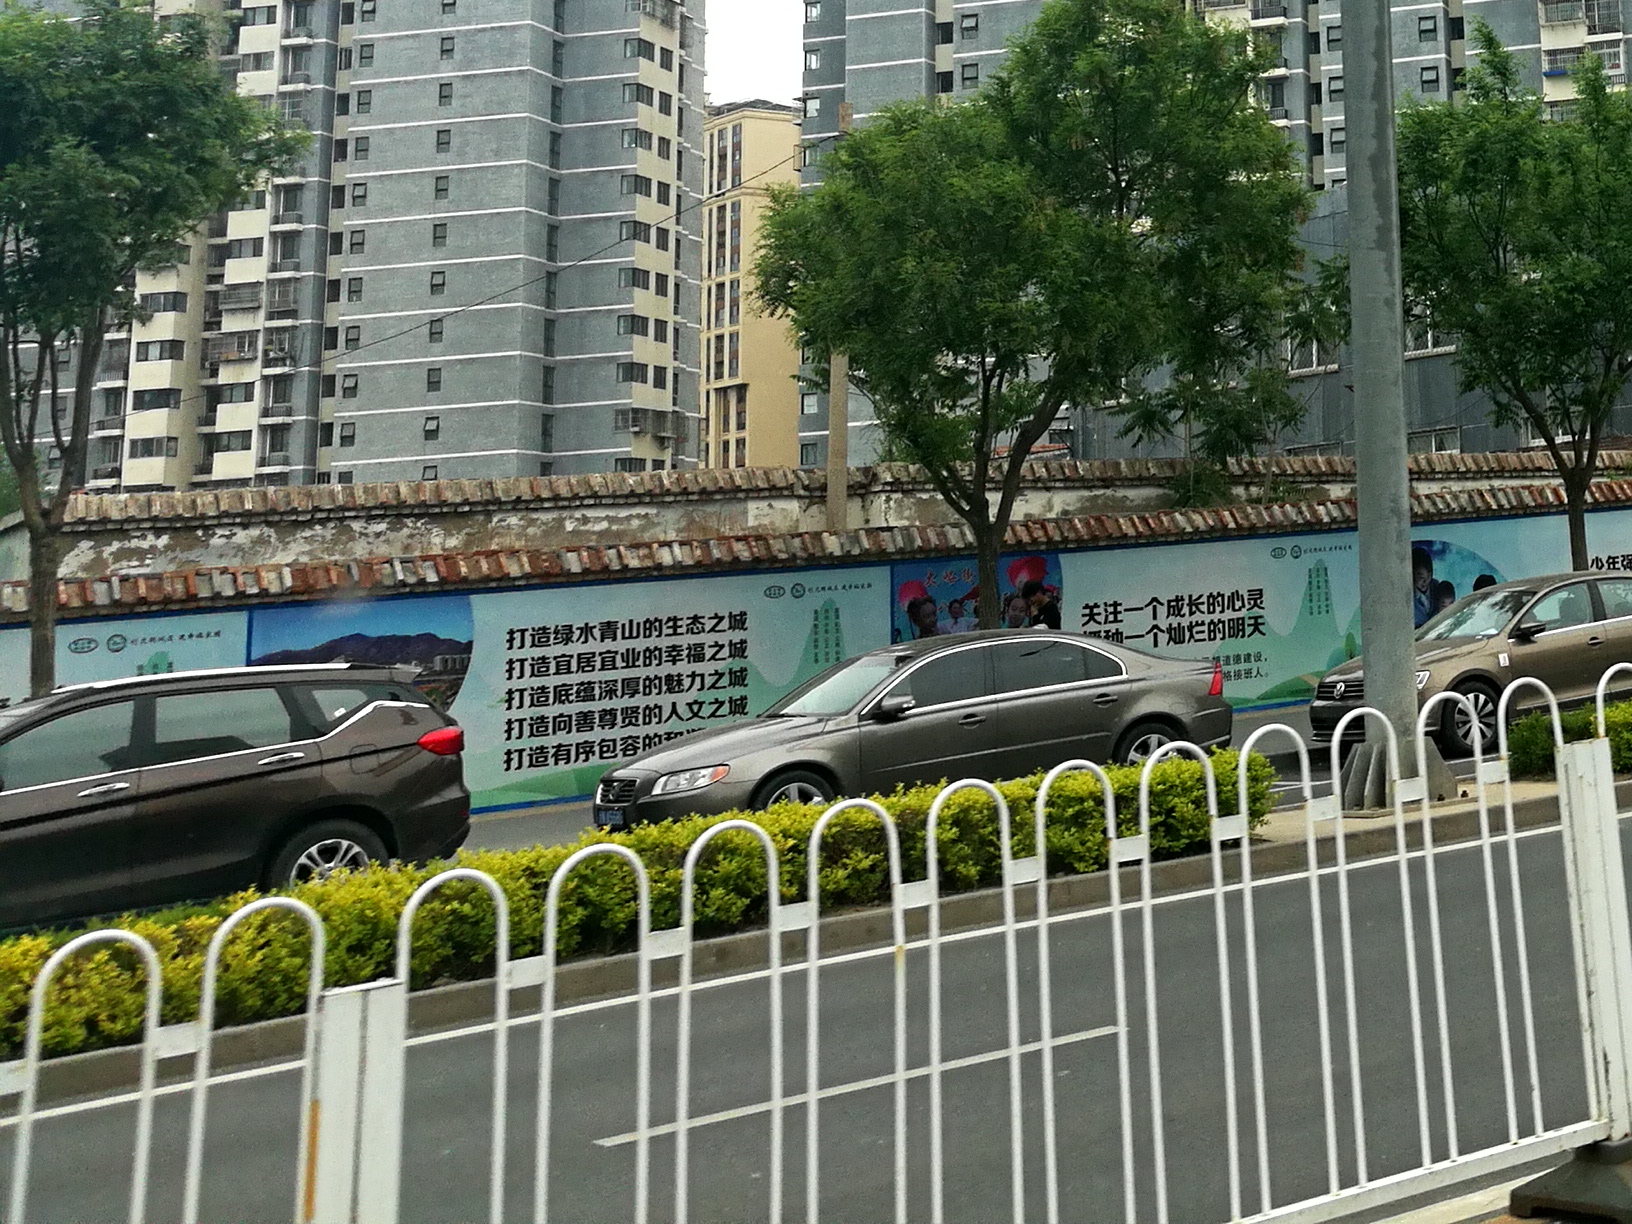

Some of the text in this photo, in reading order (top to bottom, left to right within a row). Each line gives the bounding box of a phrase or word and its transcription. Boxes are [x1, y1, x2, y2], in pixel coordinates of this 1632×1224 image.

[1081, 588, 1266, 627] 关注一个成长的心灵
[506, 610, 748, 651] 打造绿水青山的生态之城
[505, 638, 748, 681] 打造宜居宜业的幸福之城
[504, 666, 749, 711] 打造底蕴深厚的魅力之城
[504, 695, 750, 742] 打造向善尊贤的人文之城
[503, 727, 706, 772] 打造有序包容的
